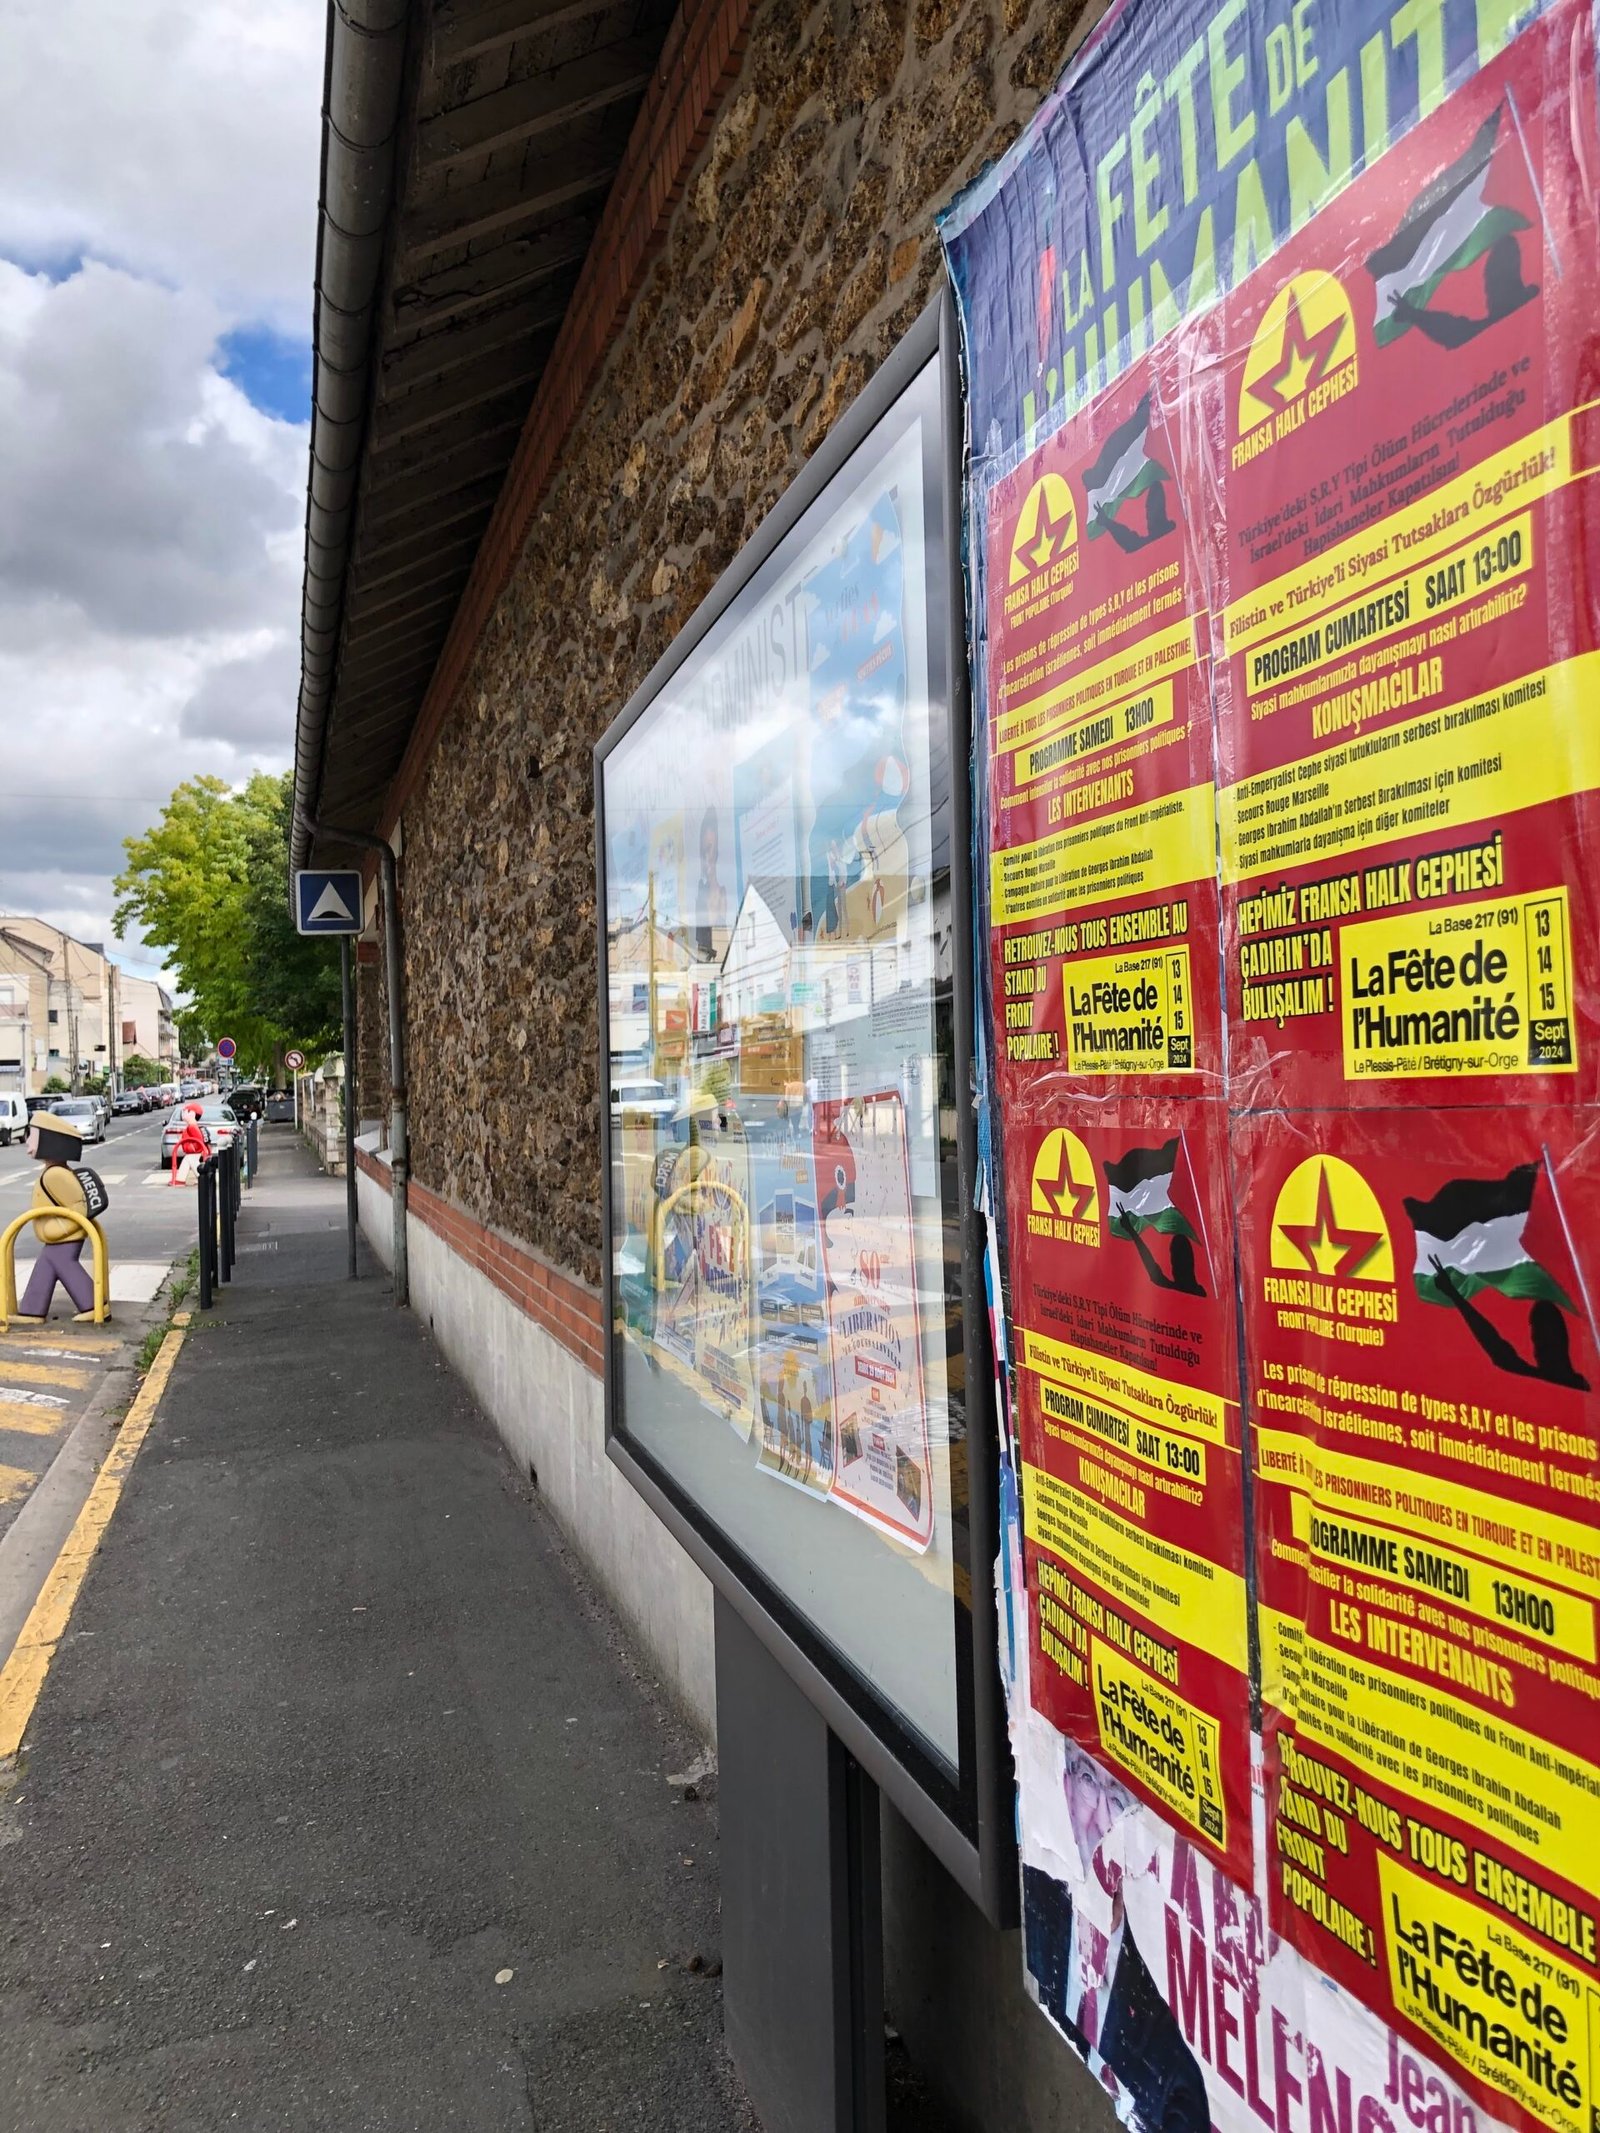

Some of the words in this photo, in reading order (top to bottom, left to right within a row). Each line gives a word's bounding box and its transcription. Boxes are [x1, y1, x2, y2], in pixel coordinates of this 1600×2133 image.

[1062, 249, 1095, 333] LA
[1096, 0, 1256, 292] FÊTE
[1266, 0, 1320, 118] DE
[1232, 424, 1273, 472] FRANSA
[1276, 398, 1306, 445] HALK
[1308, 353, 1359, 419] CEPHESİ
[1229, 608, 1267, 639] Filistin
[1269, 601, 1284, 616] ve
[1286, 562, 1345, 609] Türkiye'li
[1348, 540, 1388, 577] Siyasi
[1392, 504, 1469, 553] Tutsaklara
[1473, 447, 1555, 510] Özgürlük!
[1004, 589, 1029, 616] FRANSA
[1031, 573, 1049, 601] HALK
[1050, 545, 1079, 588] CEPHESİ
[1254, 630, 1321, 686] PROGRAM
[1325, 580, 1410, 655] CUMARTESİ
[1425, 559, 1465, 609] SAAT
[1473, 530, 1521, 585] 13:00
[1279, 662, 1356, 709] mahkumlarımızla
[1430, 616, 1457, 647] nasıl
[1311, 656, 1443, 739] KONUŞMACILAR
[1030, 730, 1077, 775] PROGRAMME
[1080, 715, 1114, 751] SAMEDI
[1125, 697, 1154, 732] 13H00
[1237, 770, 1295, 802] Anti-Emperyalist
[1298, 763, 1321, 780] Cephe
[1324, 749, 1347, 772] siyasi
[1349, 732, 1400, 763] tutukluların
[1403, 717, 1441, 744] serbest
[1444, 698, 1500, 731] bırakılması
[1503, 676, 1546, 710] komitesi
[1048, 797, 1061, 825] LES
[1064, 768, 1134, 819] INTERVENANTS
[1238, 805, 1264, 824] Secours
[1266, 796, 1289, 814] Rouge
[1292, 783, 1329, 806] Marseille
[1239, 827, 1265, 847] Georges
[1267, 817, 1297, 837] Ibrahim
[1300, 803, 1342, 828] Abdallah'ın
[1345, 792, 1376, 815] Serbest
[1378, 776, 1431, 805] Bırakılması
[1435, 769, 1453, 793] için
[1458, 753, 1502, 783] komitesi
[1239, 849, 1258, 869] Siyasi
[1260, 839, 1311, 863] mahkumlarla
[1357, 818, 1373, 840] için
[1376, 811, 1399, 831] diğer
[1402, 799, 1450, 824] komiteler
[1238, 885, 1296, 935] HEPİMİZ
[1300, 875, 1361, 924] FRANSA
[1365, 862, 1412, 910] HALK
[1416, 835, 1503, 899] CEPHESİ
[1004, 924, 1078, 964] RETROUVEZ-NOUS
[1082, 919, 1107, 944] TOUS
[1110, 906, 1170, 945] ENSEMBLE
[1173, 902, 1188, 933] AU
[1429, 920, 1442, 935] La
[1444, 918, 1473, 932] Base
[1475, 912, 1494, 929] 217
[1497, 907, 1518, 928] (91)
[1535, 909, 1549, 937] 13
[1005, 967, 1034, 996] STAND
[1037, 966, 1046, 991] DU
[1115, 962, 1123, 973] La
[1124, 959, 1140, 972] Base
[1141, 957, 1150, 970] 217
[1152, 956, 1163, 970] (91)
[1172, 960, 1180, 979] 13
[1240, 930, 1333, 983] ÇADIRIN'DA
[1351, 958, 1384, 999] La
[1389, 949, 1455, 994] Fête
[1460, 939, 1508, 986] de
[1538, 945, 1552, 974] 14
[1006, 1002, 1034, 1028] FRONT
[1070, 986, 1091, 1017] La
[1092, 982, 1131, 1014] Fête
[1133, 978, 1158, 1011] de
[1174, 984, 1182, 1004] 14
[1174, 1011, 1183, 1030] 15
[1242, 977, 1324, 1028] BULUŞALIM
[1353, 992, 1520, 1049] l'Humanité
[1540, 982, 1554, 1010] 15
[1007, 1032, 1053, 1060] POPULAIRE
[1073, 1016, 1164, 1053] l'Humanité
[1170, 1037, 1188, 1054] Sept
[1173, 1055, 1187, 1064] 2024
[1535, 1022, 1565, 1042] Sept
[1539, 1046, 1563, 1059] 2024
[1354, 1060, 1364, 1073] Le
[1425, 1052, 1518, 1072] Brétigny-sur-Orge
[77, 1171, 101, 1209] MERCI
[1027, 1214, 1052, 1237] FRANSA
[1054, 1219, 1071, 1241] HALK
[1073, 1224, 1100, 1248] CEPHESİ
[1264, 1277, 1311, 1308] FRANSA
[1337, 1288, 1398, 1322] CEPHESİ
[1278, 1311, 1305, 1330] FRONT
[1336, 1322, 1384, 1346] (Turquie)
[1045, 1387, 1084, 1424] PROGRAM
[1086, 1403, 1129, 1447] CUMARTESİ
[1136, 1429, 1160, 1462] SAAT
[1166, 1441, 1199, 1476] 13:00
[1263, 1360, 1284, 1380] Les
[1328, 1375, 1397, 1409] répression
[1401, 1388, 1417, 1411] de
[1421, 1400, 1456, 1424] types
[1495, 1414, 1509, 1437] et
[1512, 1416, 1534, 1444] les
[1538, 1425, 1598, 1461] prisons
[1411, 1428, 1436, 1453] soit
[1438, 1432, 1546, 1486] immédiatement
[1079, 1456, 1145, 1519] KONUŞMACILAR
[1261, 1449, 1297, 1473] LIBERTÉ
[1325, 1472, 1392, 1508] PRISONNIERS
[1395, 1490, 1453, 1527] POLITIQUES
[1456, 1509, 1468, 1533] EN
[1471, 1514, 1517, 1550] TURQUIE
[1520, 1531, 1534, 1555] ET
[1537, 1537, 1552, 1563] EN
[1404, 1546, 1470, 1602] SAMEDI
[1491, 1579, 1555, 1637] 13H00
[1330, 1599, 1361, 1644] LES
[1367, 1613, 1515, 1708] INTERVENANTS
[1098, 1664, 1119, 1707] La
[1119, 1679, 1159, 1735] Fête
[1161, 1714, 1185, 1754] de
[1312, 1670, 1348, 1700] Marseille
[1101, 1701, 1195, 1800] l'Humanité
[1197, 1723, 1207, 1746] 13
[1203, 1775, 1213, 1798] 15
[1276, 1819, 1325, 1881] FRONT
[1282, 1860, 1366, 1955] POPULAIRE
[1407, 1818, 1468, 1885] TOUS
[1474, 1851, 1597, 1965] ENSEMBLE
[1392, 1891, 1430, 1959] La
[1433, 1921, 1517, 2008] Fête
[1521, 1982, 1568, 2044] de
[1397, 1943, 1582, 2109] l'Humanité
